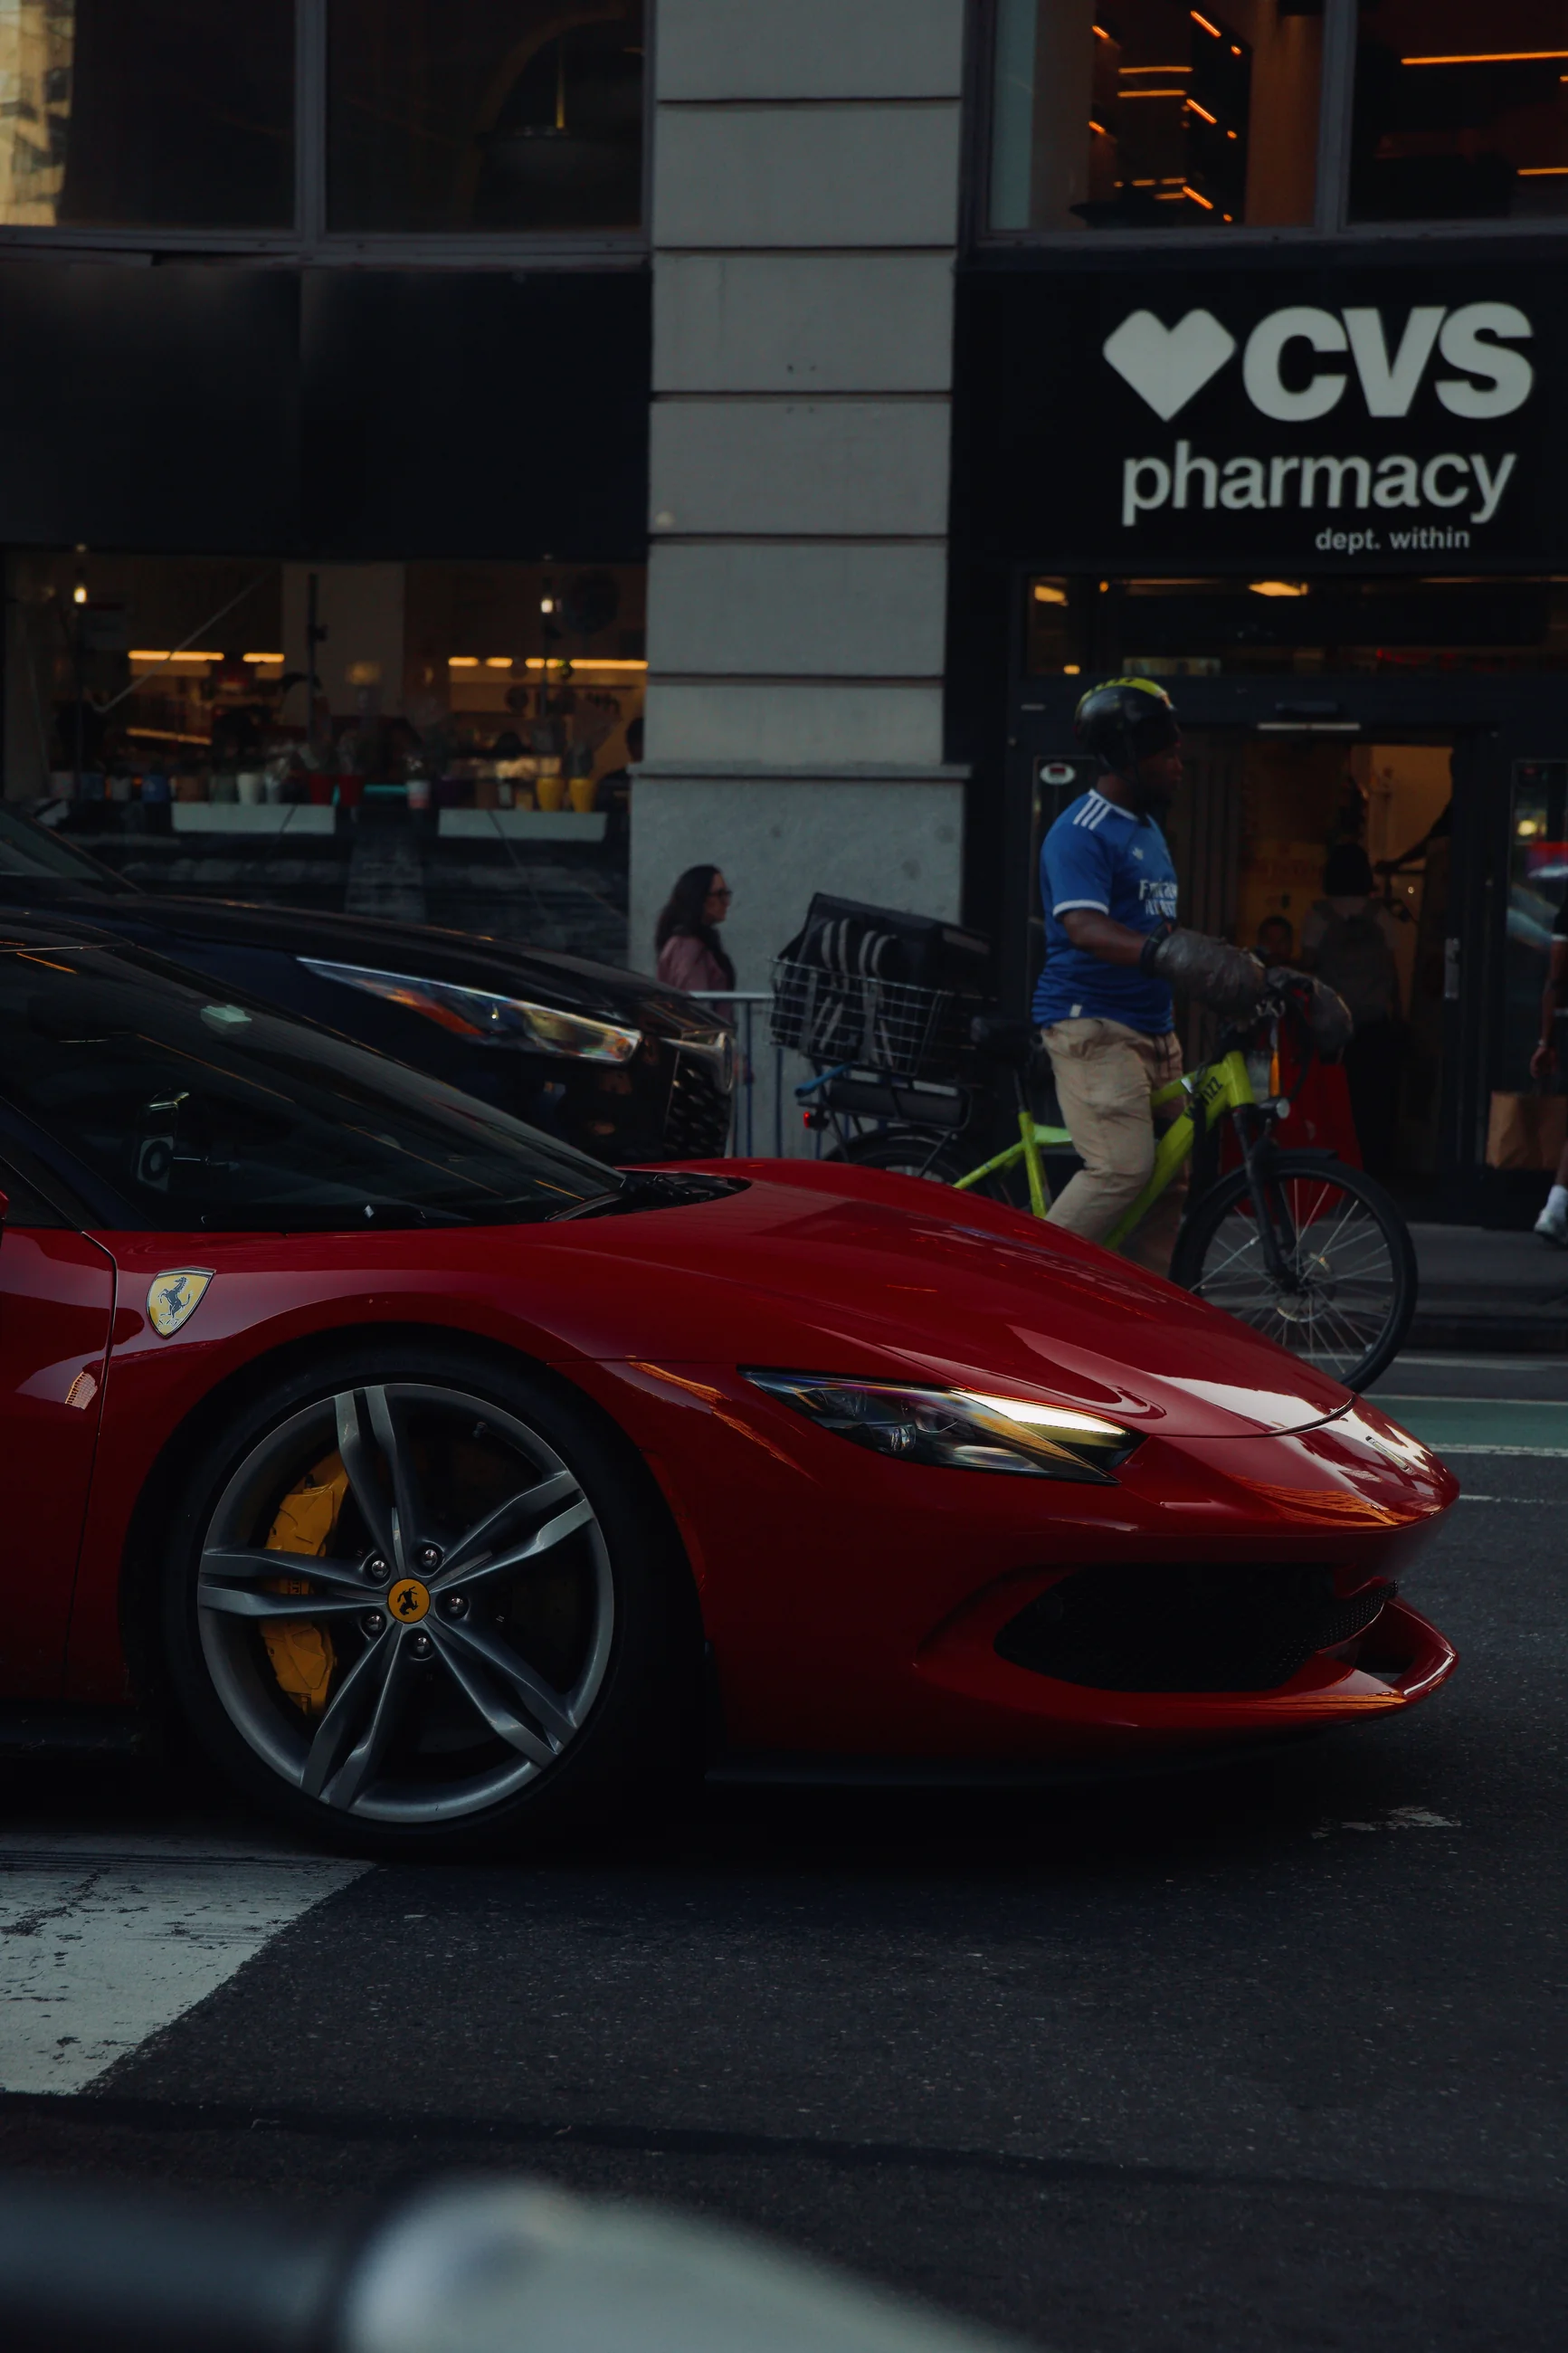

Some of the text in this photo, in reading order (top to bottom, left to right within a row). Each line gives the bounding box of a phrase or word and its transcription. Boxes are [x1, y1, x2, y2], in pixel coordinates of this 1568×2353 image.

[1242, 301, 1535, 422] CVS
[1122, 439, 1517, 528] pharmacy
[1315, 527, 1471, 556] dept. within
